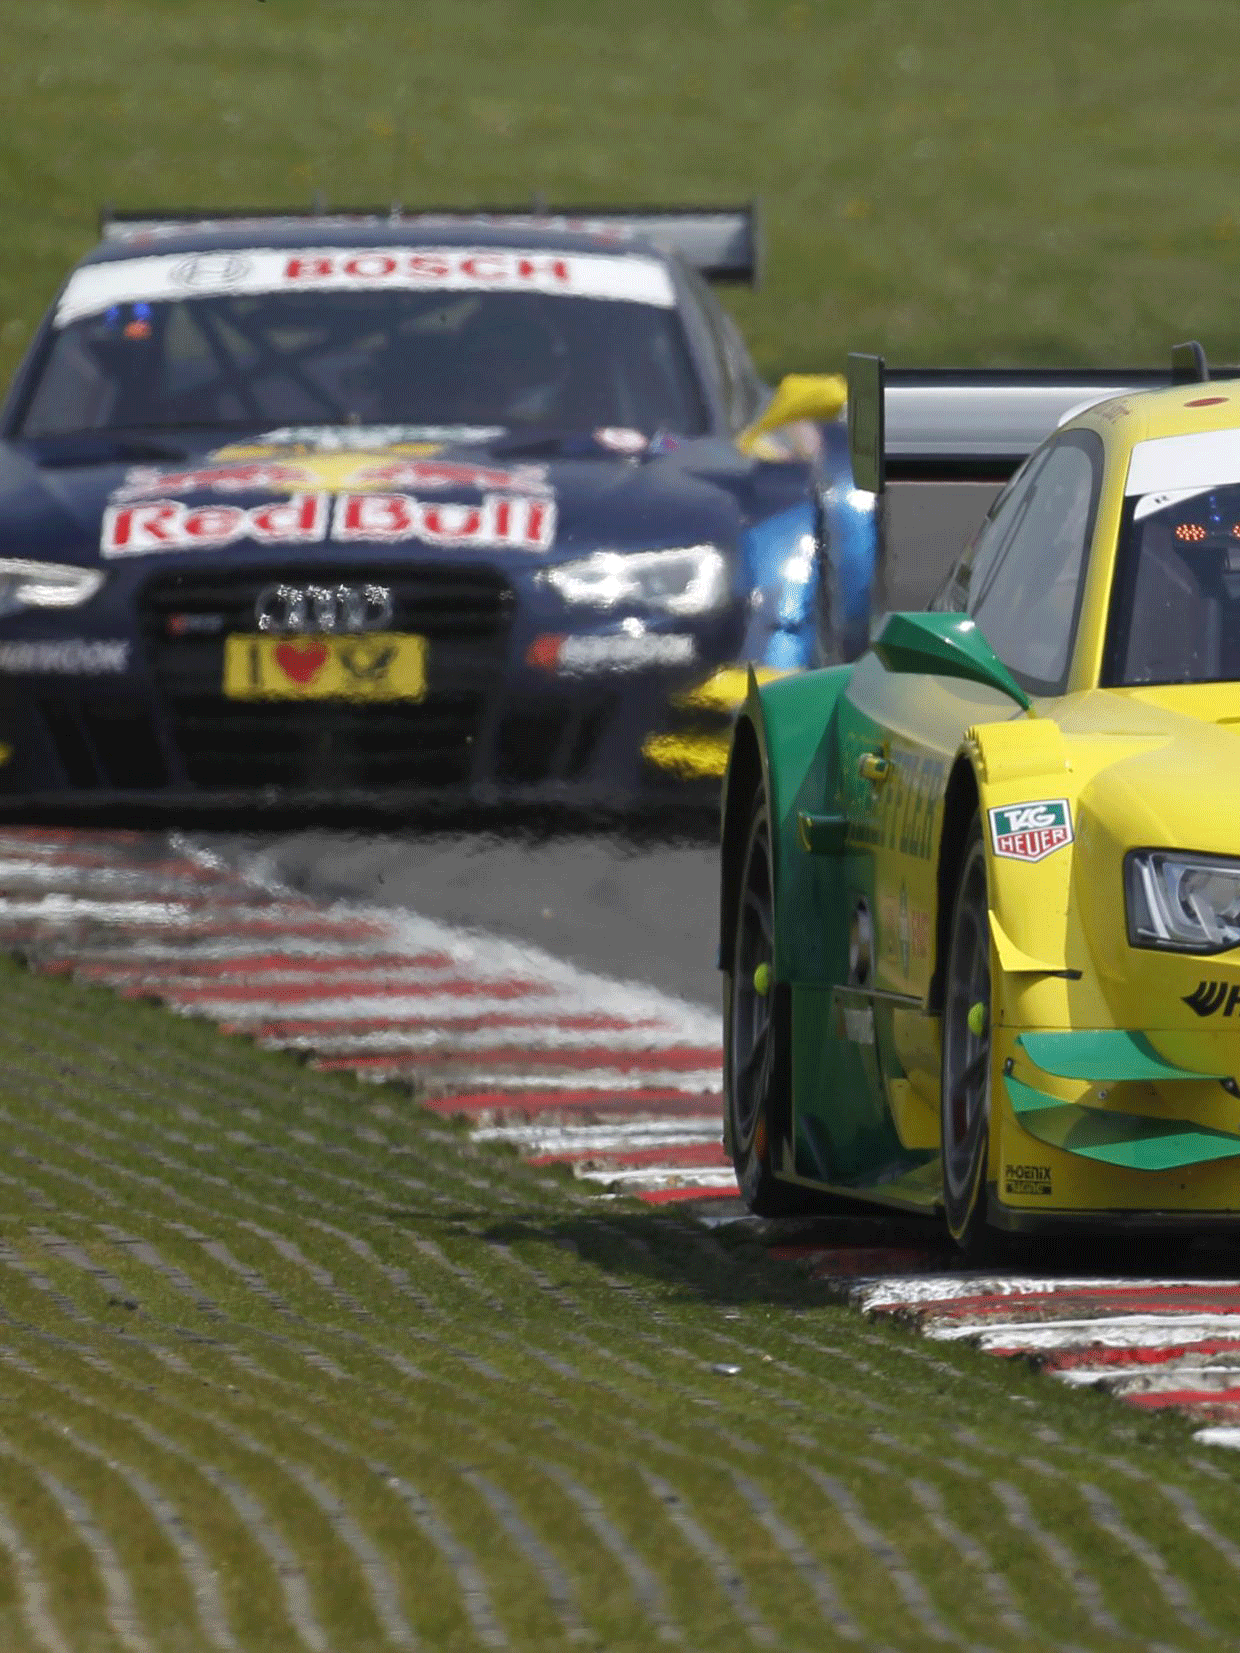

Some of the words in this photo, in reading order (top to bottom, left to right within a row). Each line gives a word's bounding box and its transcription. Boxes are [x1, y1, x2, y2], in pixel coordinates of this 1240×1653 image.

[284, 253, 571, 283] BOSCH
[98, 495, 323, 553] Red
[332, 491, 554, 550] Bull
[1003, 805, 1056, 832] TAG
[1000, 829, 1066, 856] HEUER
